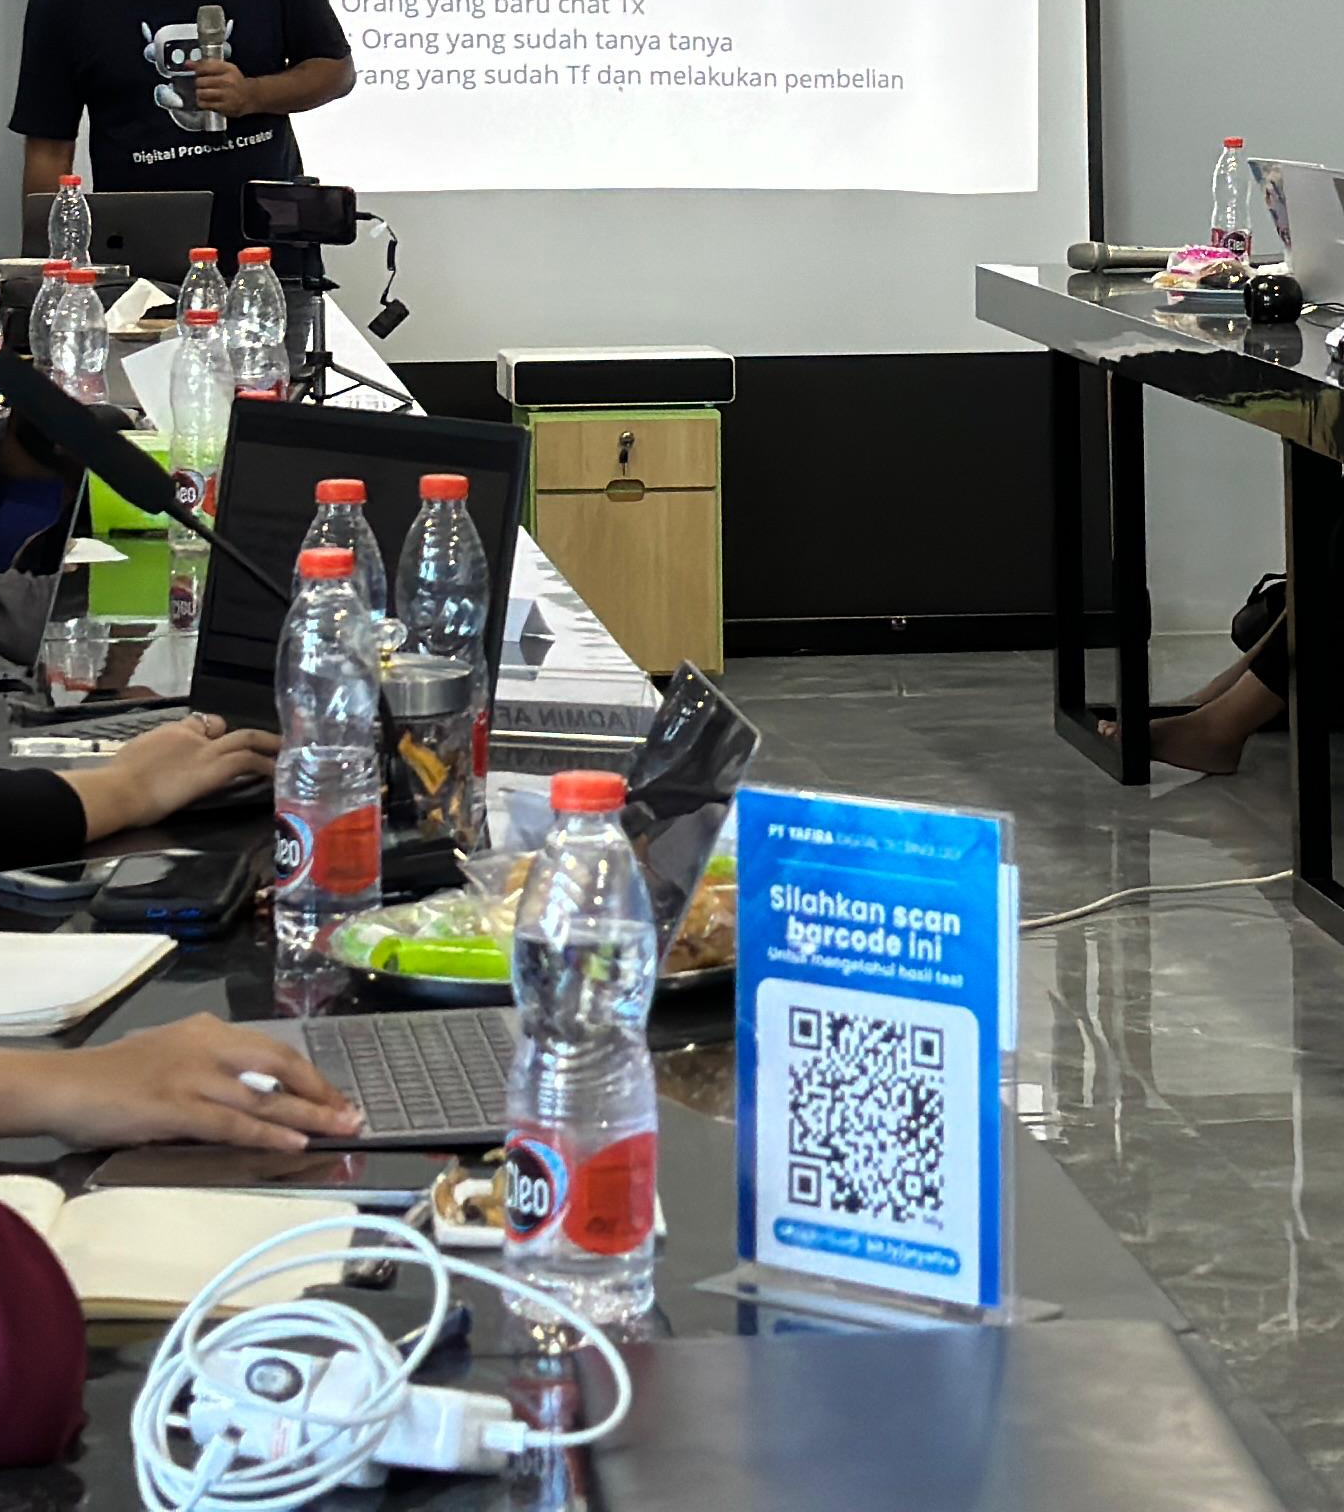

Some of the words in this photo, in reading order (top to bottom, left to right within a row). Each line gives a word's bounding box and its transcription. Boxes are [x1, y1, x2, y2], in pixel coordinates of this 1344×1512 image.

[361, 28, 439, 53] Orang
[446, 32, 506, 54] yang
[513, 28, 587, 49] sudah
[595, 31, 661, 56] tanya
[668, 32, 733, 57] tanya
[356, 68, 409, 89] rang
[416, 68, 476, 90] yang
[484, 65, 558, 85] sudah
[565, 65, 592, 85] Tf
[597, 65, 641, 85] dan
[649, 65, 777, 87] melakukan
[784, 68, 904, 93] pembelian
[132, 147, 176, 164] Digital
[769, 883, 886, 925] Silahkan
[892, 905, 961, 936] scan
[786, 915, 903, 957] barcode
[908, 930, 943, 963] ini
